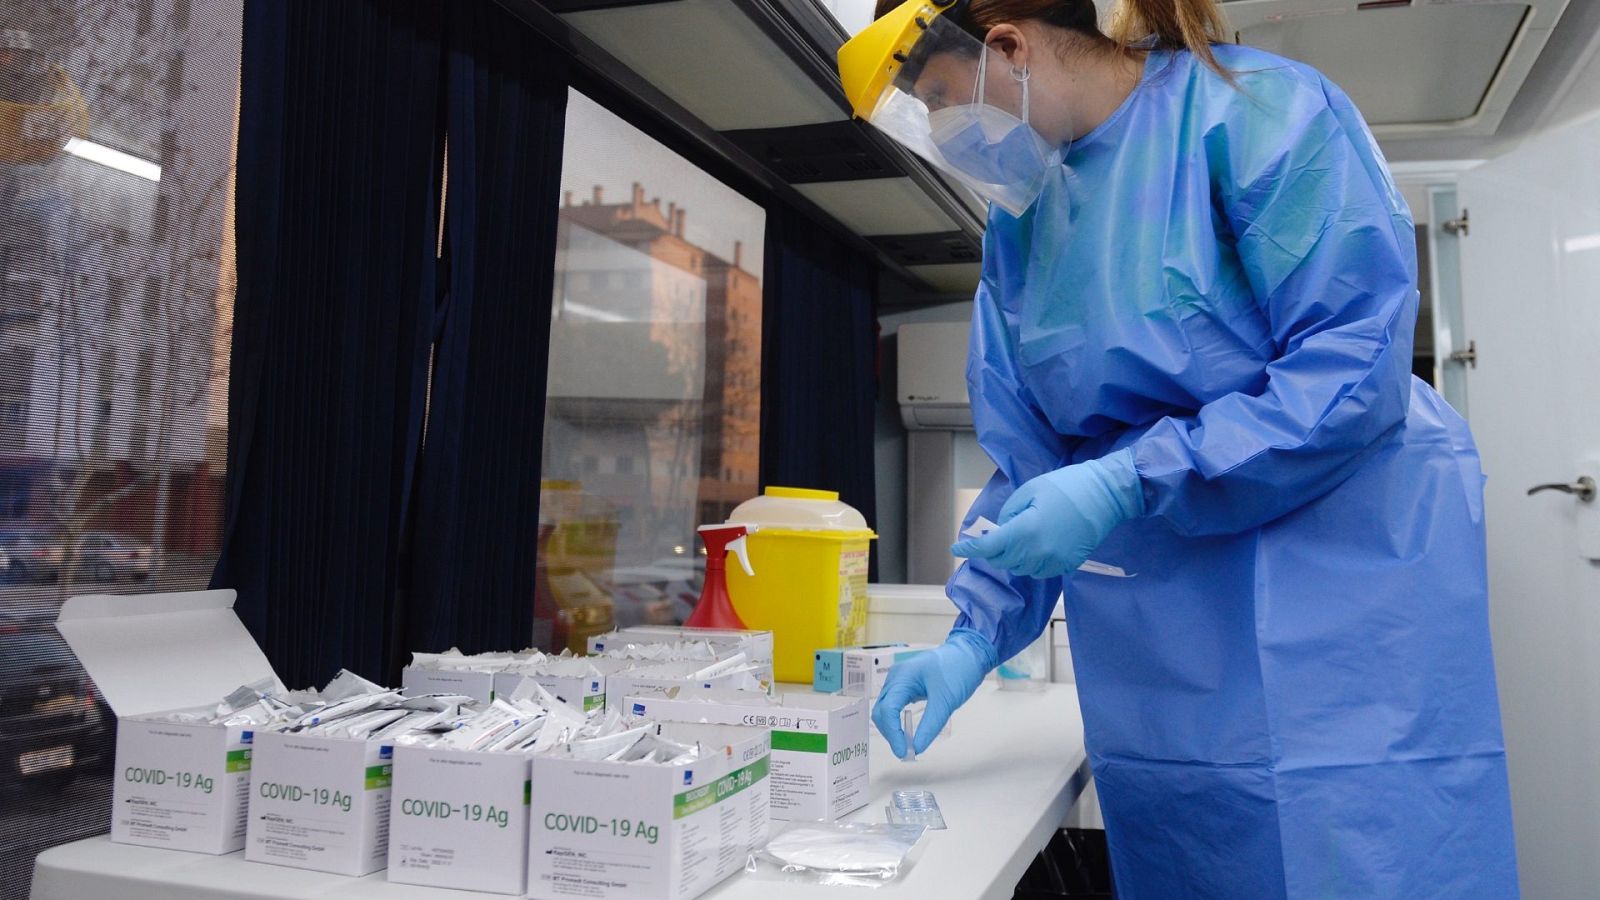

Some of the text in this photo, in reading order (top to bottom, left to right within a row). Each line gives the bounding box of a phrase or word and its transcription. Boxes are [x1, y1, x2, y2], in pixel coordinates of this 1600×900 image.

[822, 661, 831, 672] M
[832, 743, 861, 766] COVID-19
[125, 767, 214, 794] COVID-19 Ag
[260, 782, 352, 812] COVID-19 Ag
[402, 798, 508, 828] COVID-19 Ag
[544, 813, 659, 844] COVID-19 Ag
